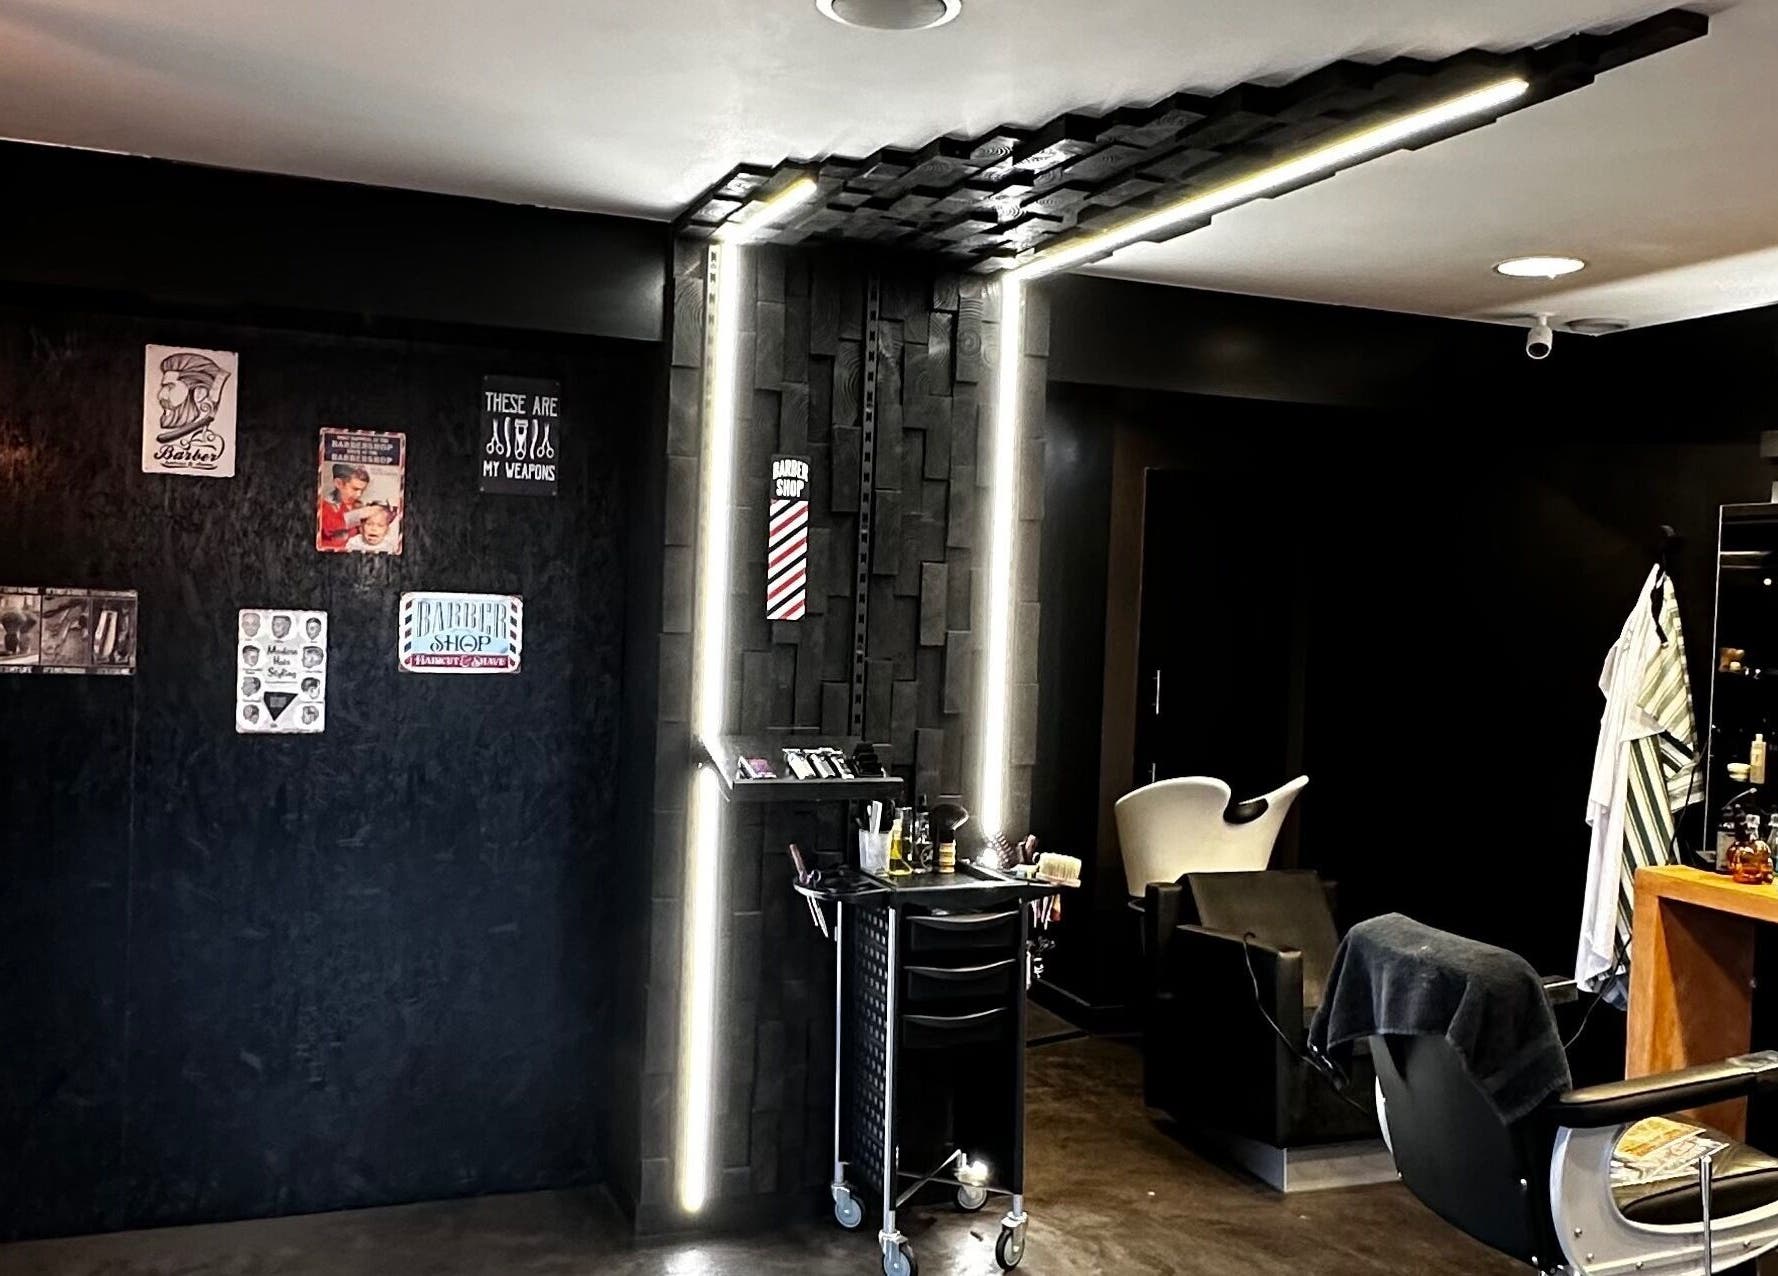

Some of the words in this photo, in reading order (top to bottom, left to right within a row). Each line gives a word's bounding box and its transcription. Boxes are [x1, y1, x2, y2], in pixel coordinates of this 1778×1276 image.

[485, 391, 527, 415] THESE
[532, 396, 559, 417] ARE
[153, 444, 219, 462] Barber
[483, 460, 500, 477] MY
[505, 461, 556, 481] WEAPONS
[772, 459, 809, 482] BARBER
[775, 478, 805, 498] SHOP
[416, 600, 507, 640] BARBER
[429, 634, 492, 653] SHOP
